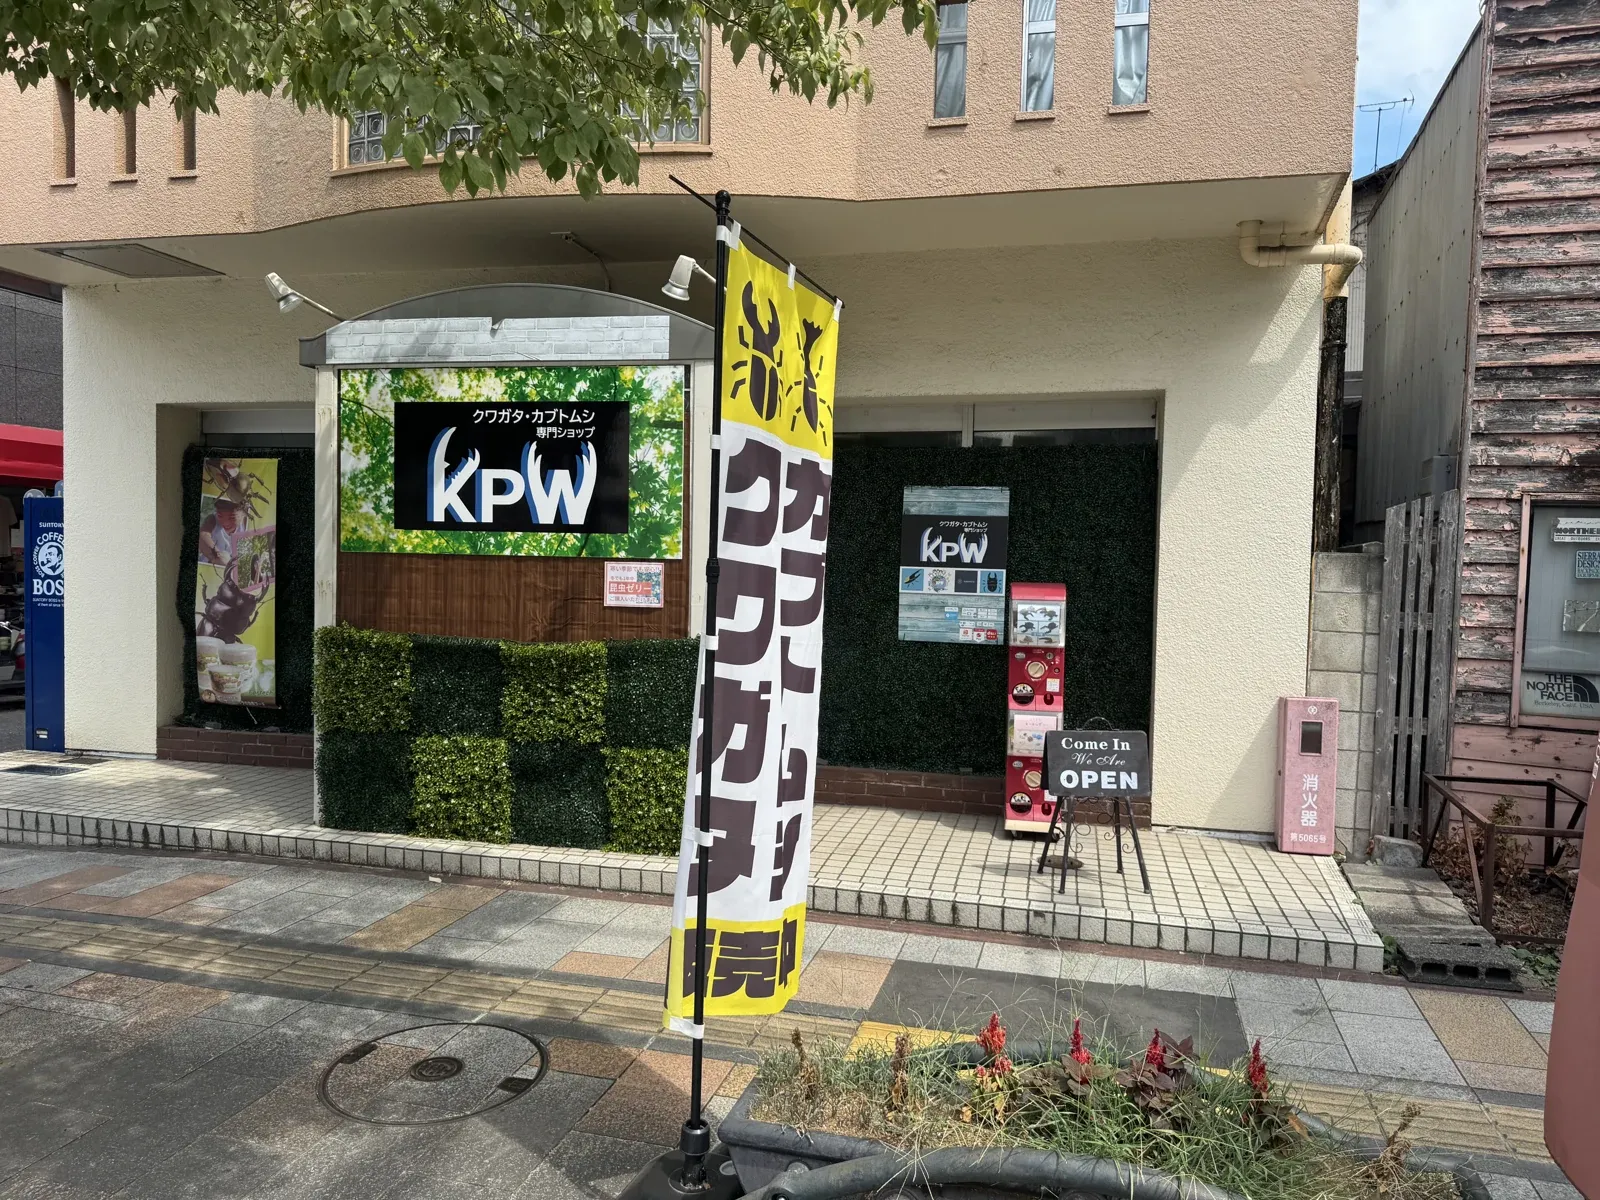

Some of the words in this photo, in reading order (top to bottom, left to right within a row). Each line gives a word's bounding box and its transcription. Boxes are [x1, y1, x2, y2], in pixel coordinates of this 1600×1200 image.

[473, 408, 595, 424] クワガタ・カブトムシ
[536, 426, 595, 439] 専門ショップ
[427, 426, 597, 525] KPW
[939, 520, 988, 528] クワガタ・カブトムシ
[1553, 527, 1600, 535] NORTHE
[919, 526, 989, 564] KPW
[610, 583, 651, 593] 昆虫ゼリー
[687, 437, 782, 897] クワガタ
[770, 457, 832, 902] カブトムシ
[1545, 673, 1572, 684] THE
[1526, 681, 1573, 693] NORTH
[1540, 691, 1574, 702] FACE
[1061, 737, 1108, 751] Come
[1112, 738, 1131, 751] In
[1071, 752, 1092, 765] We
[1096, 753, 1126, 766] Are
[1060, 769, 1139, 790] OPEN
[1300, 773, 1319, 827] 消火器
